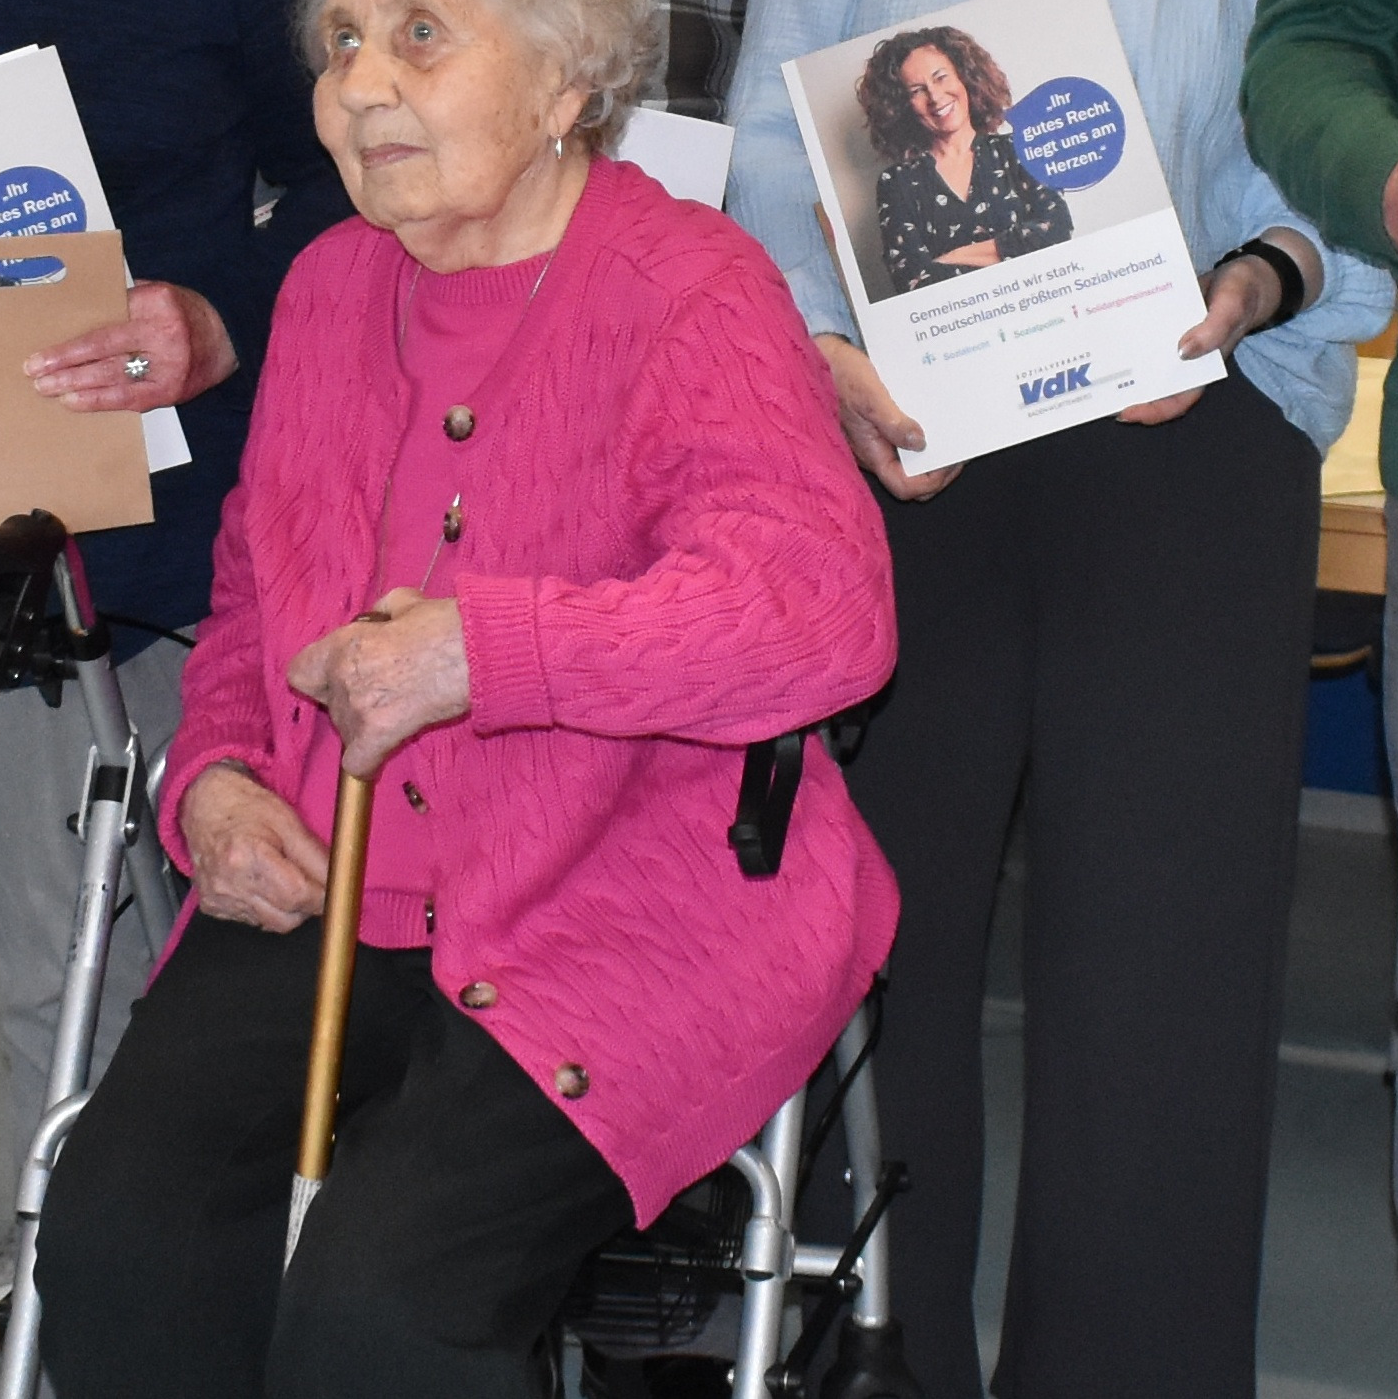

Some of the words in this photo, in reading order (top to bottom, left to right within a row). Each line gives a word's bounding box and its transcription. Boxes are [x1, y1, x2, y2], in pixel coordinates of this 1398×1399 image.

[1022, 117, 1064, 142] gutes
[1065, 100, 1111, 125] Recht
[1023, 140, 1059, 161] liegt
[1060, 132, 1089, 149] uns
[1091, 122, 1117, 139] am
[23, 189, 72, 215] Recht
[50, 211, 78, 229] am
[909, 290, 990, 324] Gemeinsam
[992, 279, 1021, 298] sind
[1022, 273, 1043, 288] wir
[1045, 262, 1085, 281] stark,
[915, 329, 928, 342] in
[929, 302, 1016, 338] Deutschlands
[1018, 283, 1073, 312] größtem
[1074, 252, 1167, 291] Sozialverband.
[1019, 362, 1092, 406] VdK
